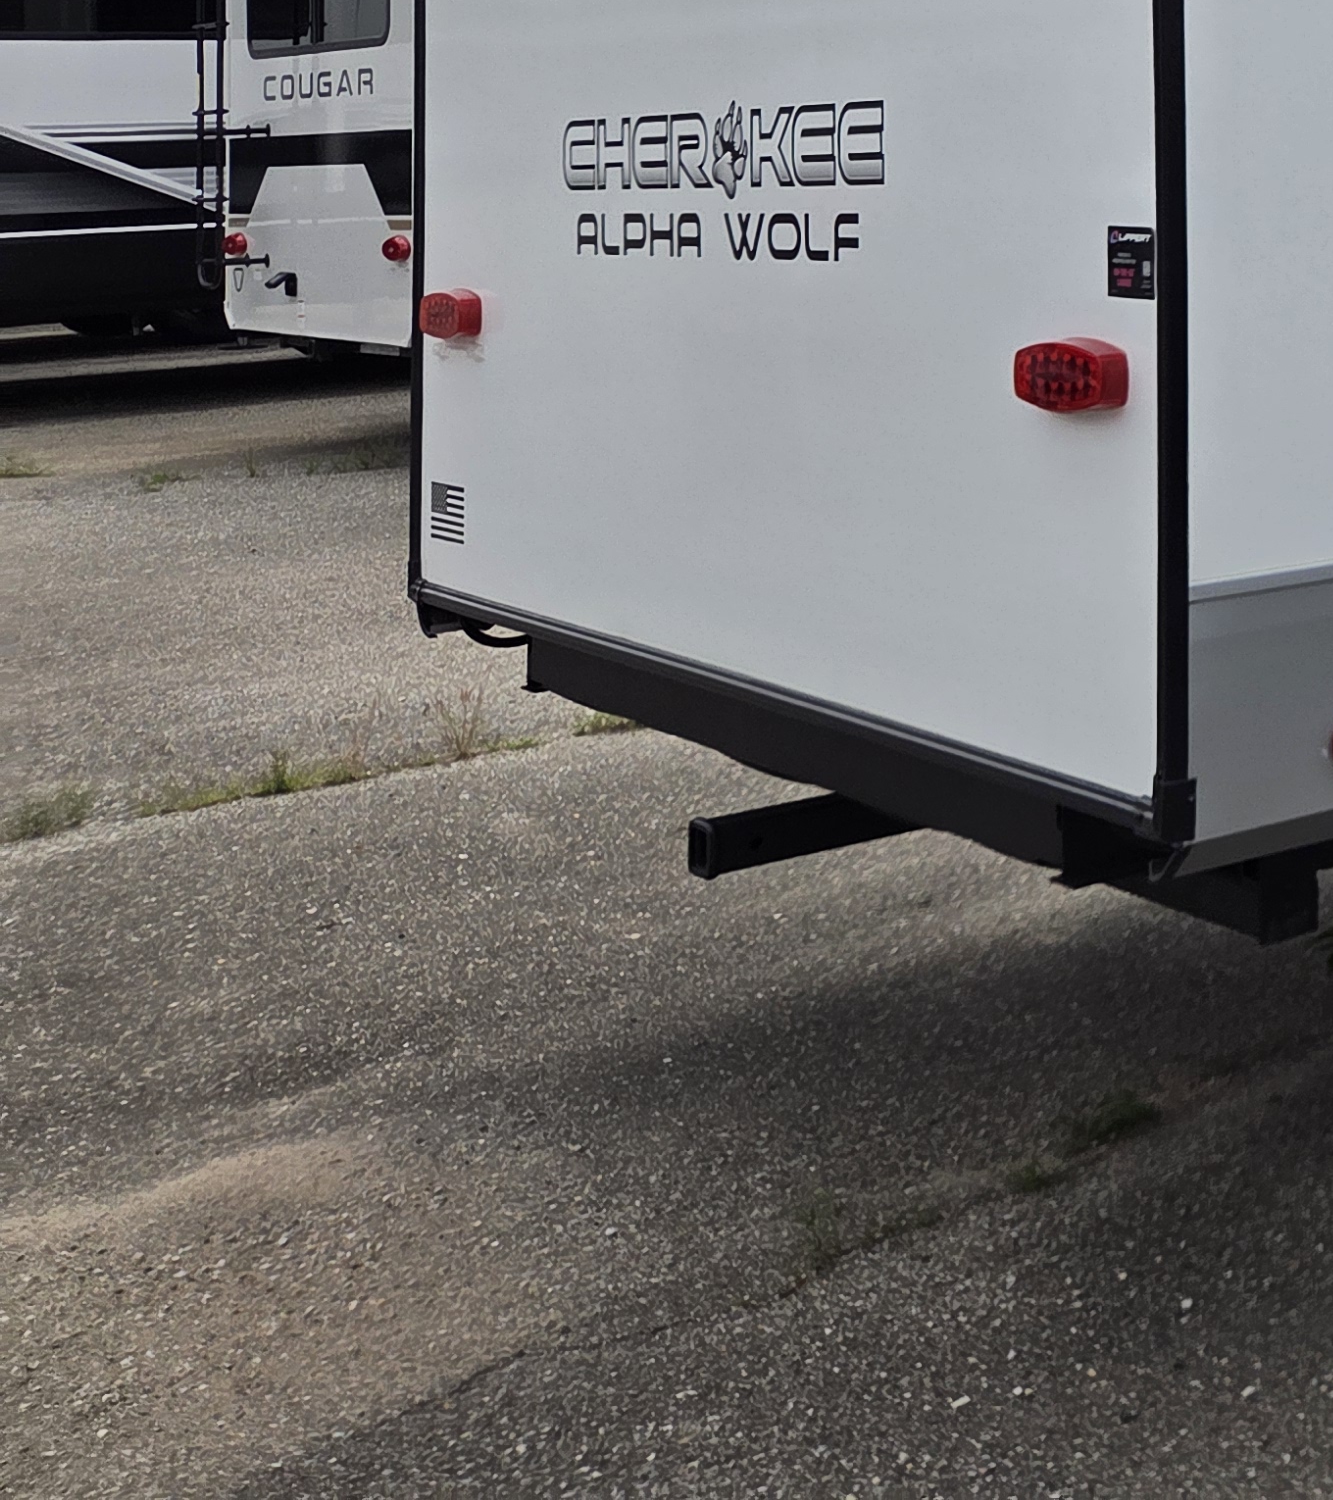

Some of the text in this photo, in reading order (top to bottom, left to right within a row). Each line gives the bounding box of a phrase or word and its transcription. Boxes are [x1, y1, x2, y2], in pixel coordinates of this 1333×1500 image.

[263, 68, 373, 101] COUGAR
[577, 213, 859, 261] ALPHA WOLF
